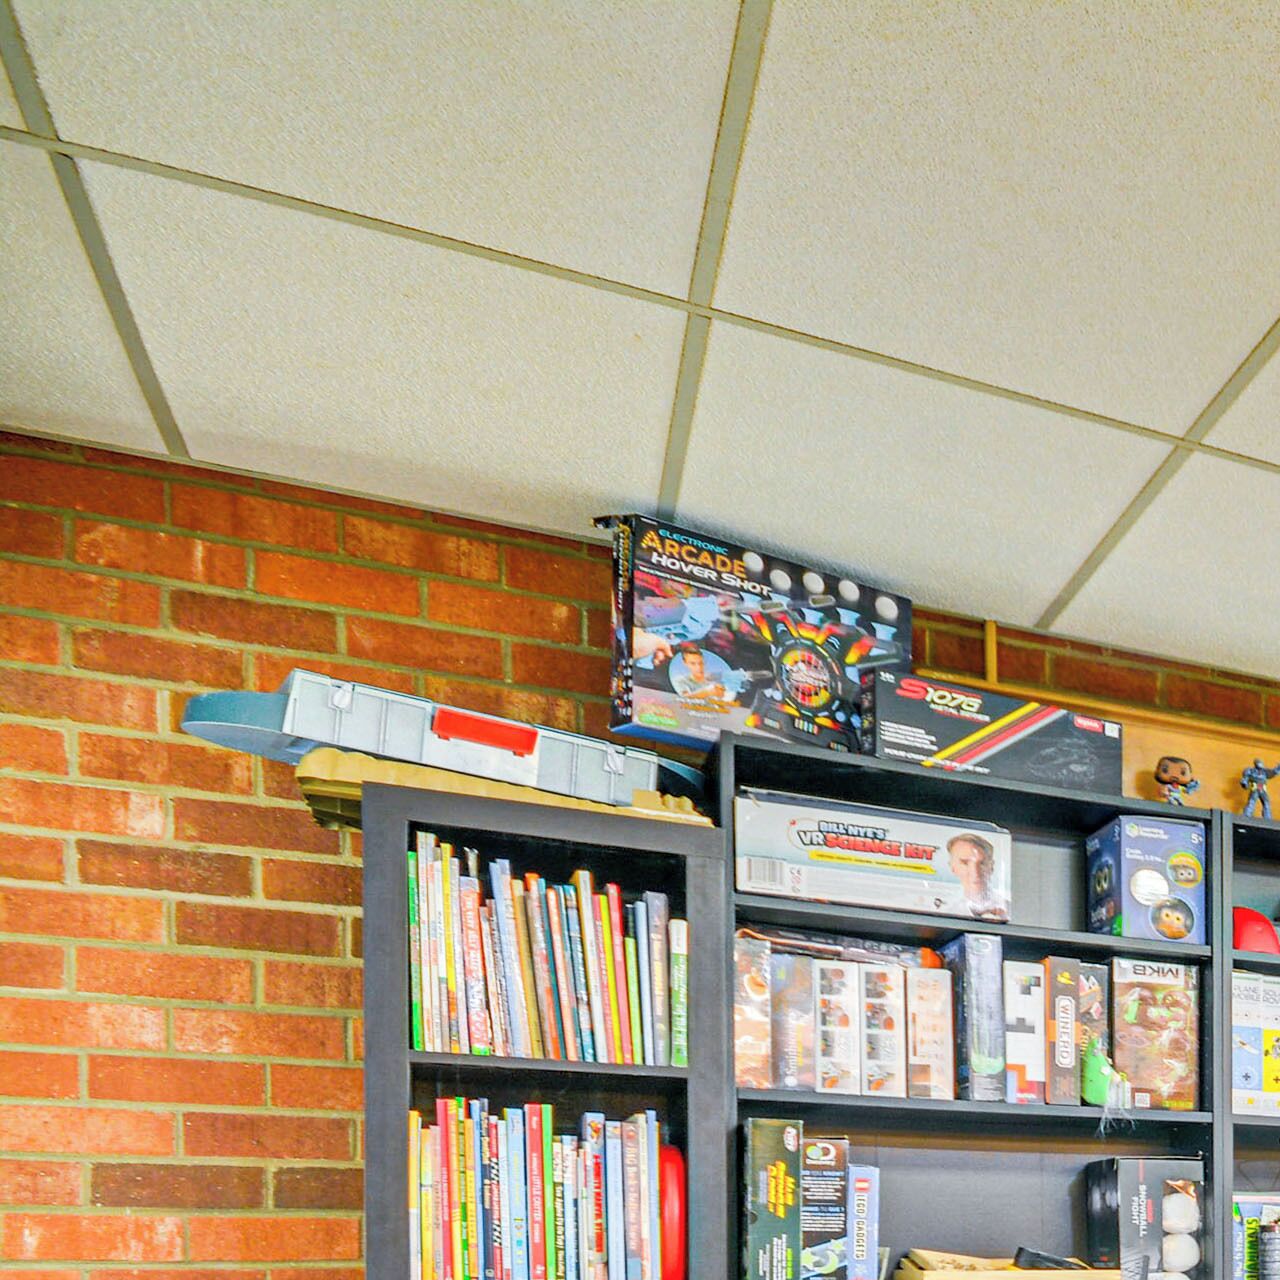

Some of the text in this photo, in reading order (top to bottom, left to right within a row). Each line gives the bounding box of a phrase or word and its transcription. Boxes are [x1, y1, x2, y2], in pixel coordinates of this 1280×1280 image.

[641, 530, 748, 579] ARCADE
[658, 528, 729, 555] ELECTRONIC
[651, 551, 718, 581] HOVER
[720, 572, 774, 597] SHOT
[797, 830, 937, 861] VR SCIENCE KIT
[818, 820, 886, 840] BILL NYE'S
[855, 1193, 867, 1215] LEGO
[1131, 1196, 1140, 1226] FIGHT
[1138, 1184, 1148, 1238] SNOWBALL
[855, 1219, 867, 1260] GADGETS
[1246, 1218, 1259, 1272] ANIMALS
